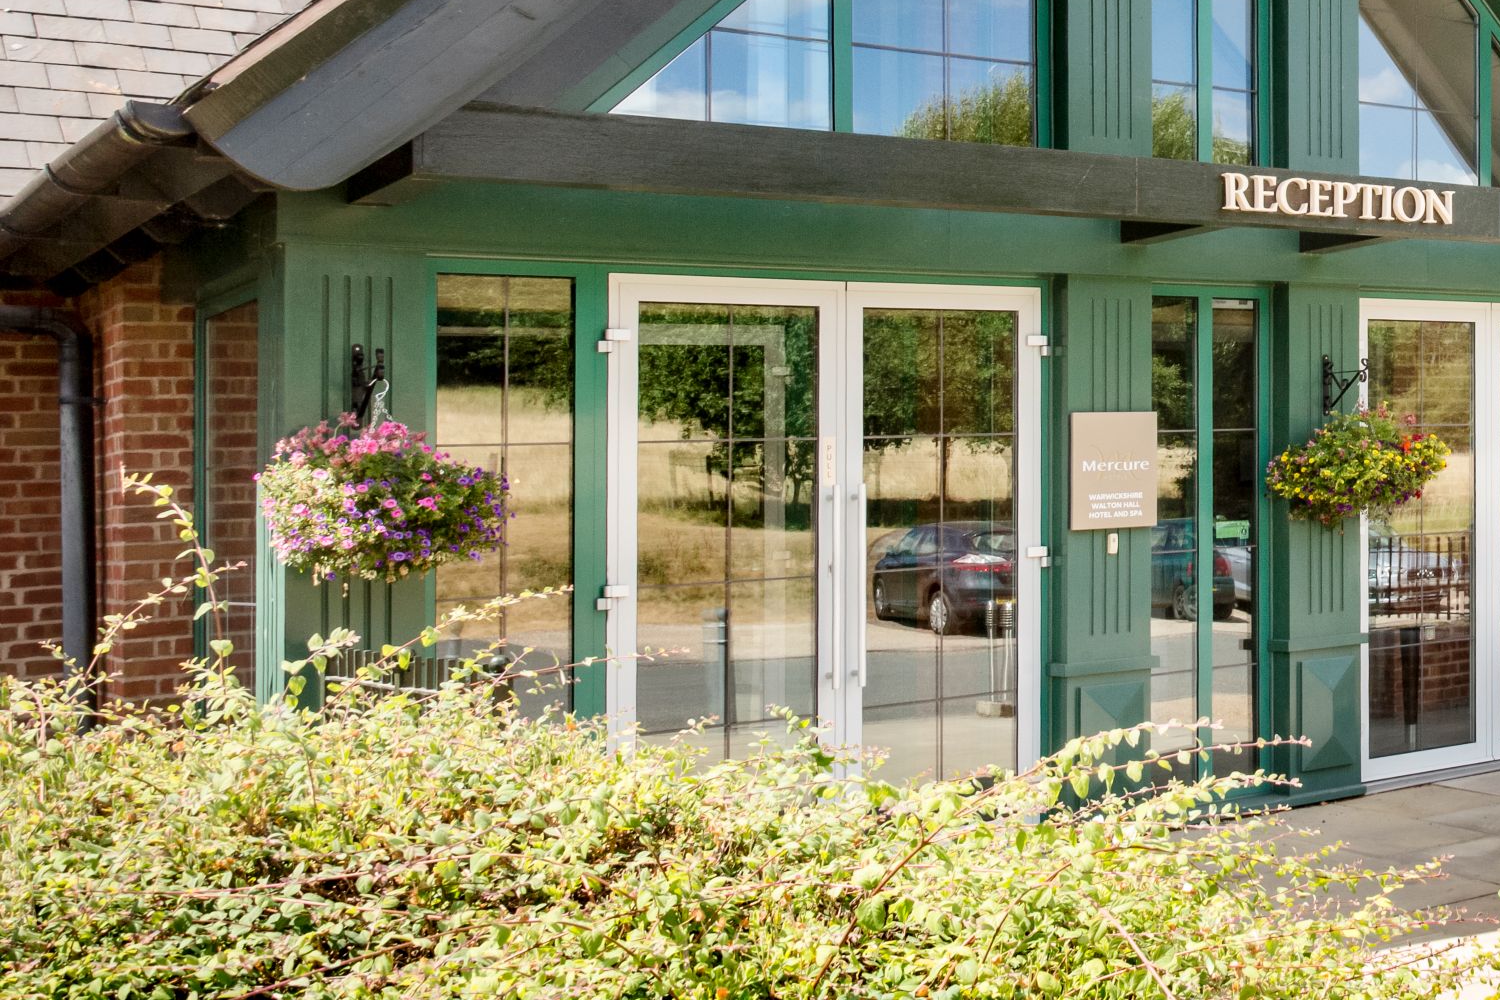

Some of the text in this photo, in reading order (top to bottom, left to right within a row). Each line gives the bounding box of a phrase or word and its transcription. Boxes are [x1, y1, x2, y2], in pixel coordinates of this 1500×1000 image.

[1220, 172, 1456, 225] RECEPTION
[1082, 459, 1150, 472] Mercure
[1088, 491, 1143, 501] WARWICKSHIRE
[1091, 500, 1140, 510] WALTON HALL
[1088, 511, 1113, 519] HOTEL
[1129, 509, 1143, 517] SPA
